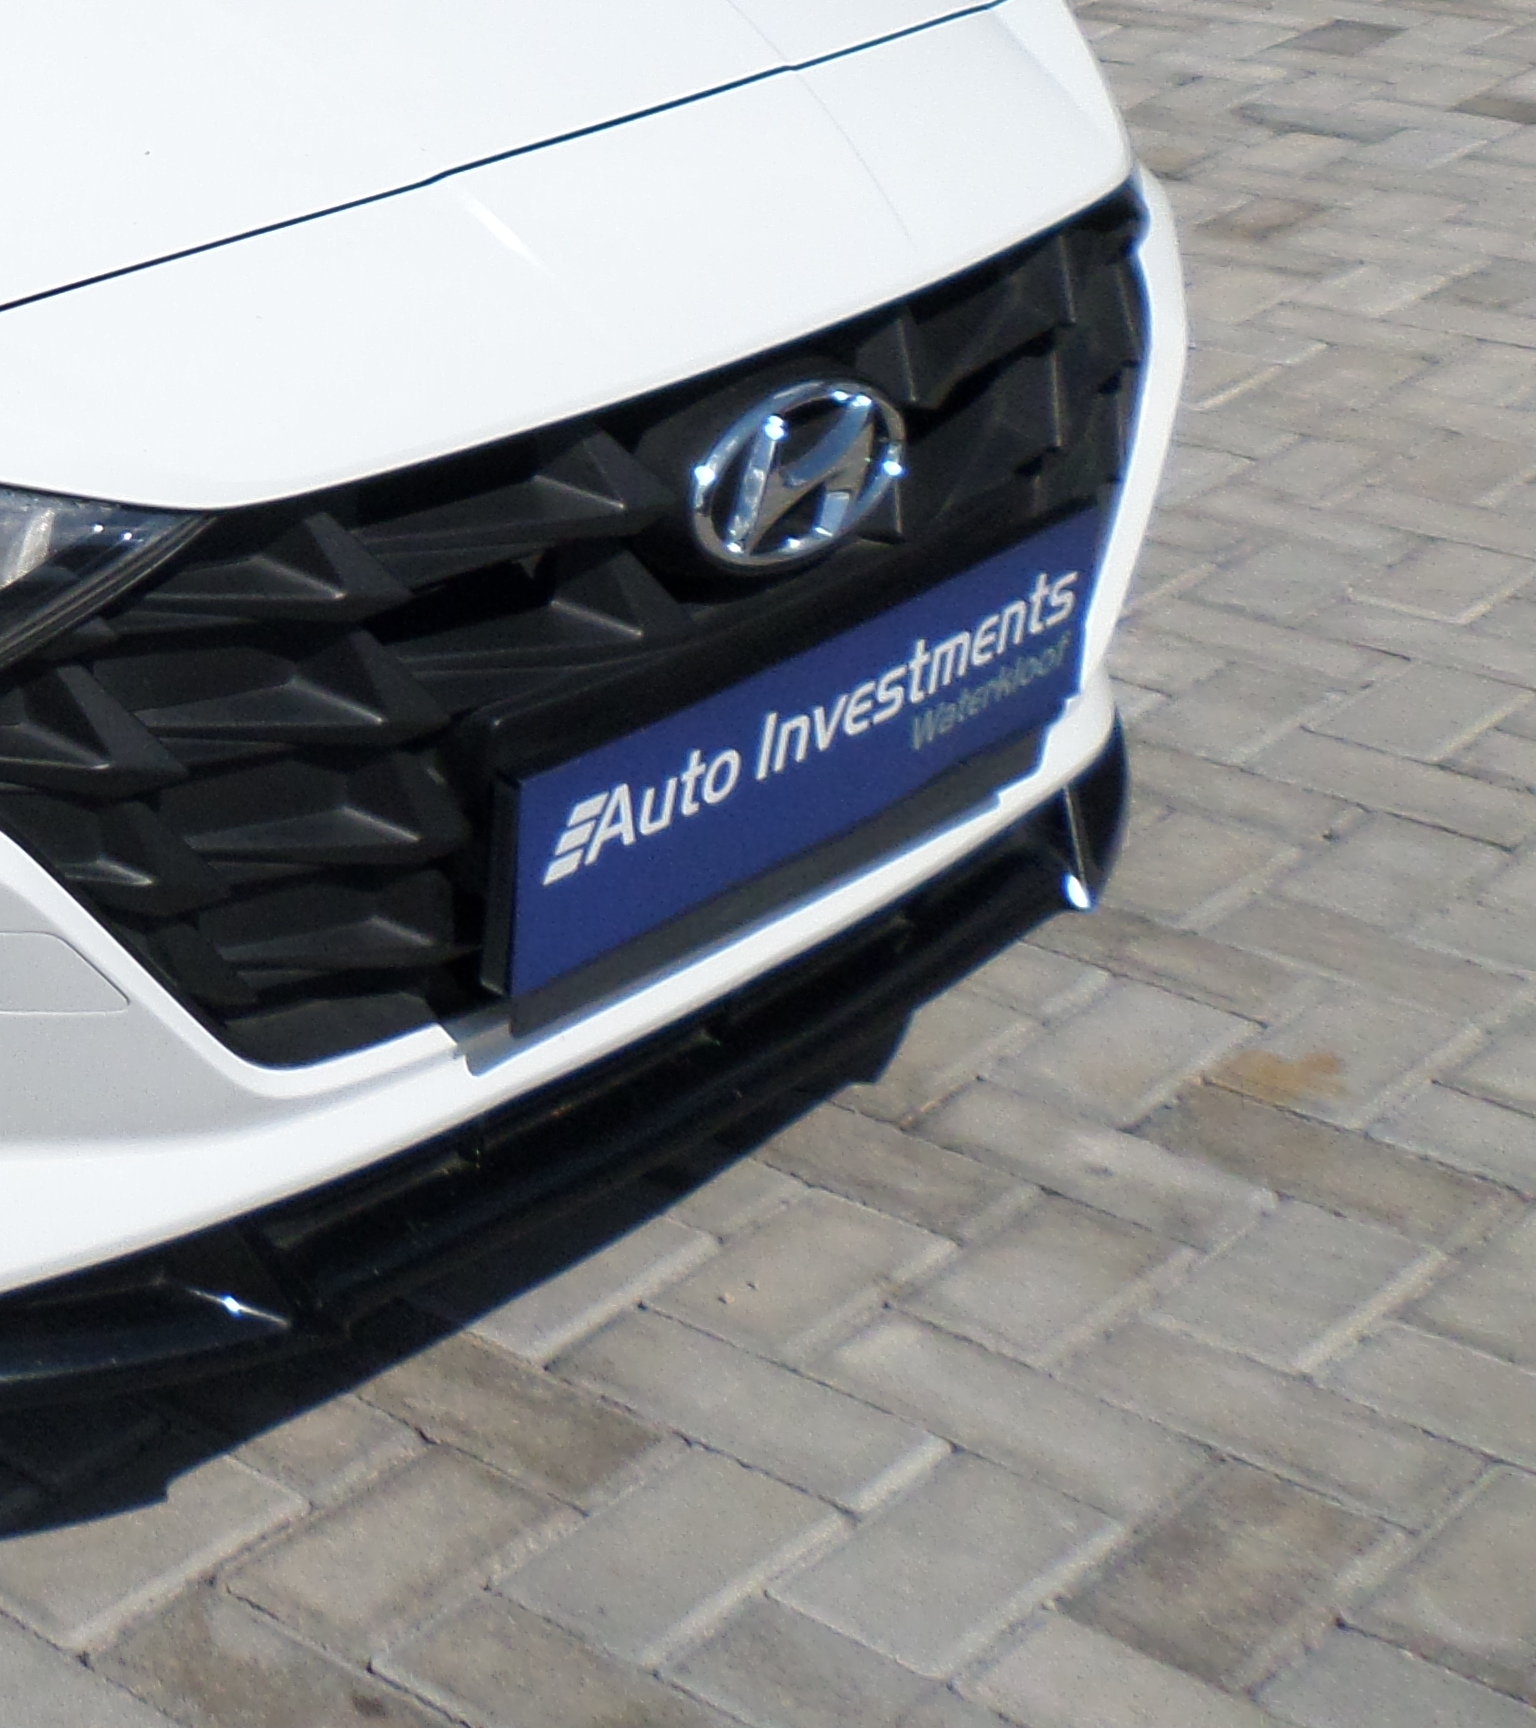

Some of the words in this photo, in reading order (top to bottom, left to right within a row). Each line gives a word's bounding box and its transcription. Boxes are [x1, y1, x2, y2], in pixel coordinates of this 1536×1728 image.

[585, 746, 741, 866] Auto
[755, 571, 1078, 780] Investments
[912, 630, 1071, 750] Waterkloof
